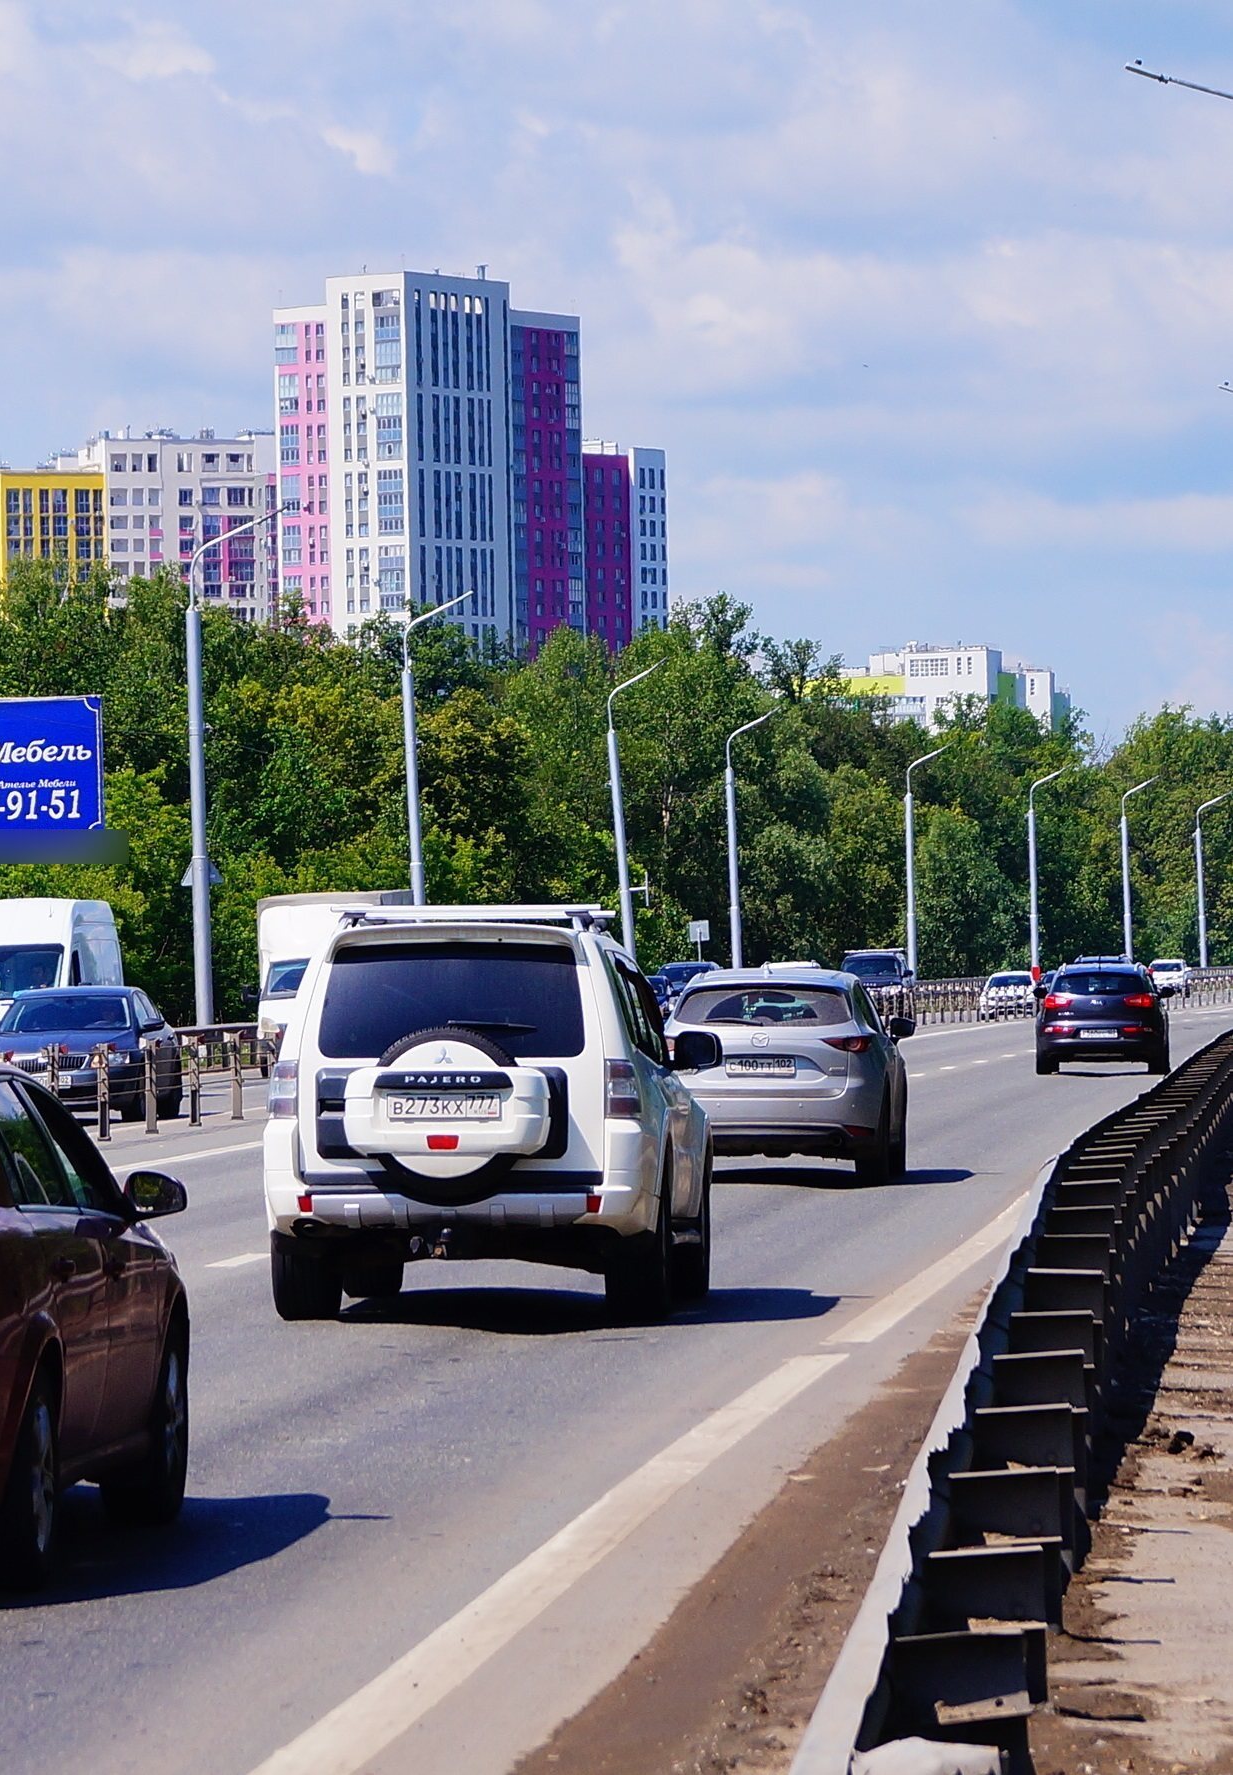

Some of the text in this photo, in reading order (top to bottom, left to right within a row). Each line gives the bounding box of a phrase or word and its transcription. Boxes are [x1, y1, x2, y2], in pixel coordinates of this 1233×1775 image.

[37, 778, 77, 788] Мебели
[775, 1059, 792, 1068] 102
[404, 1075, 482, 1084] PAJERO
[468, 1095, 494, 1109] 777
